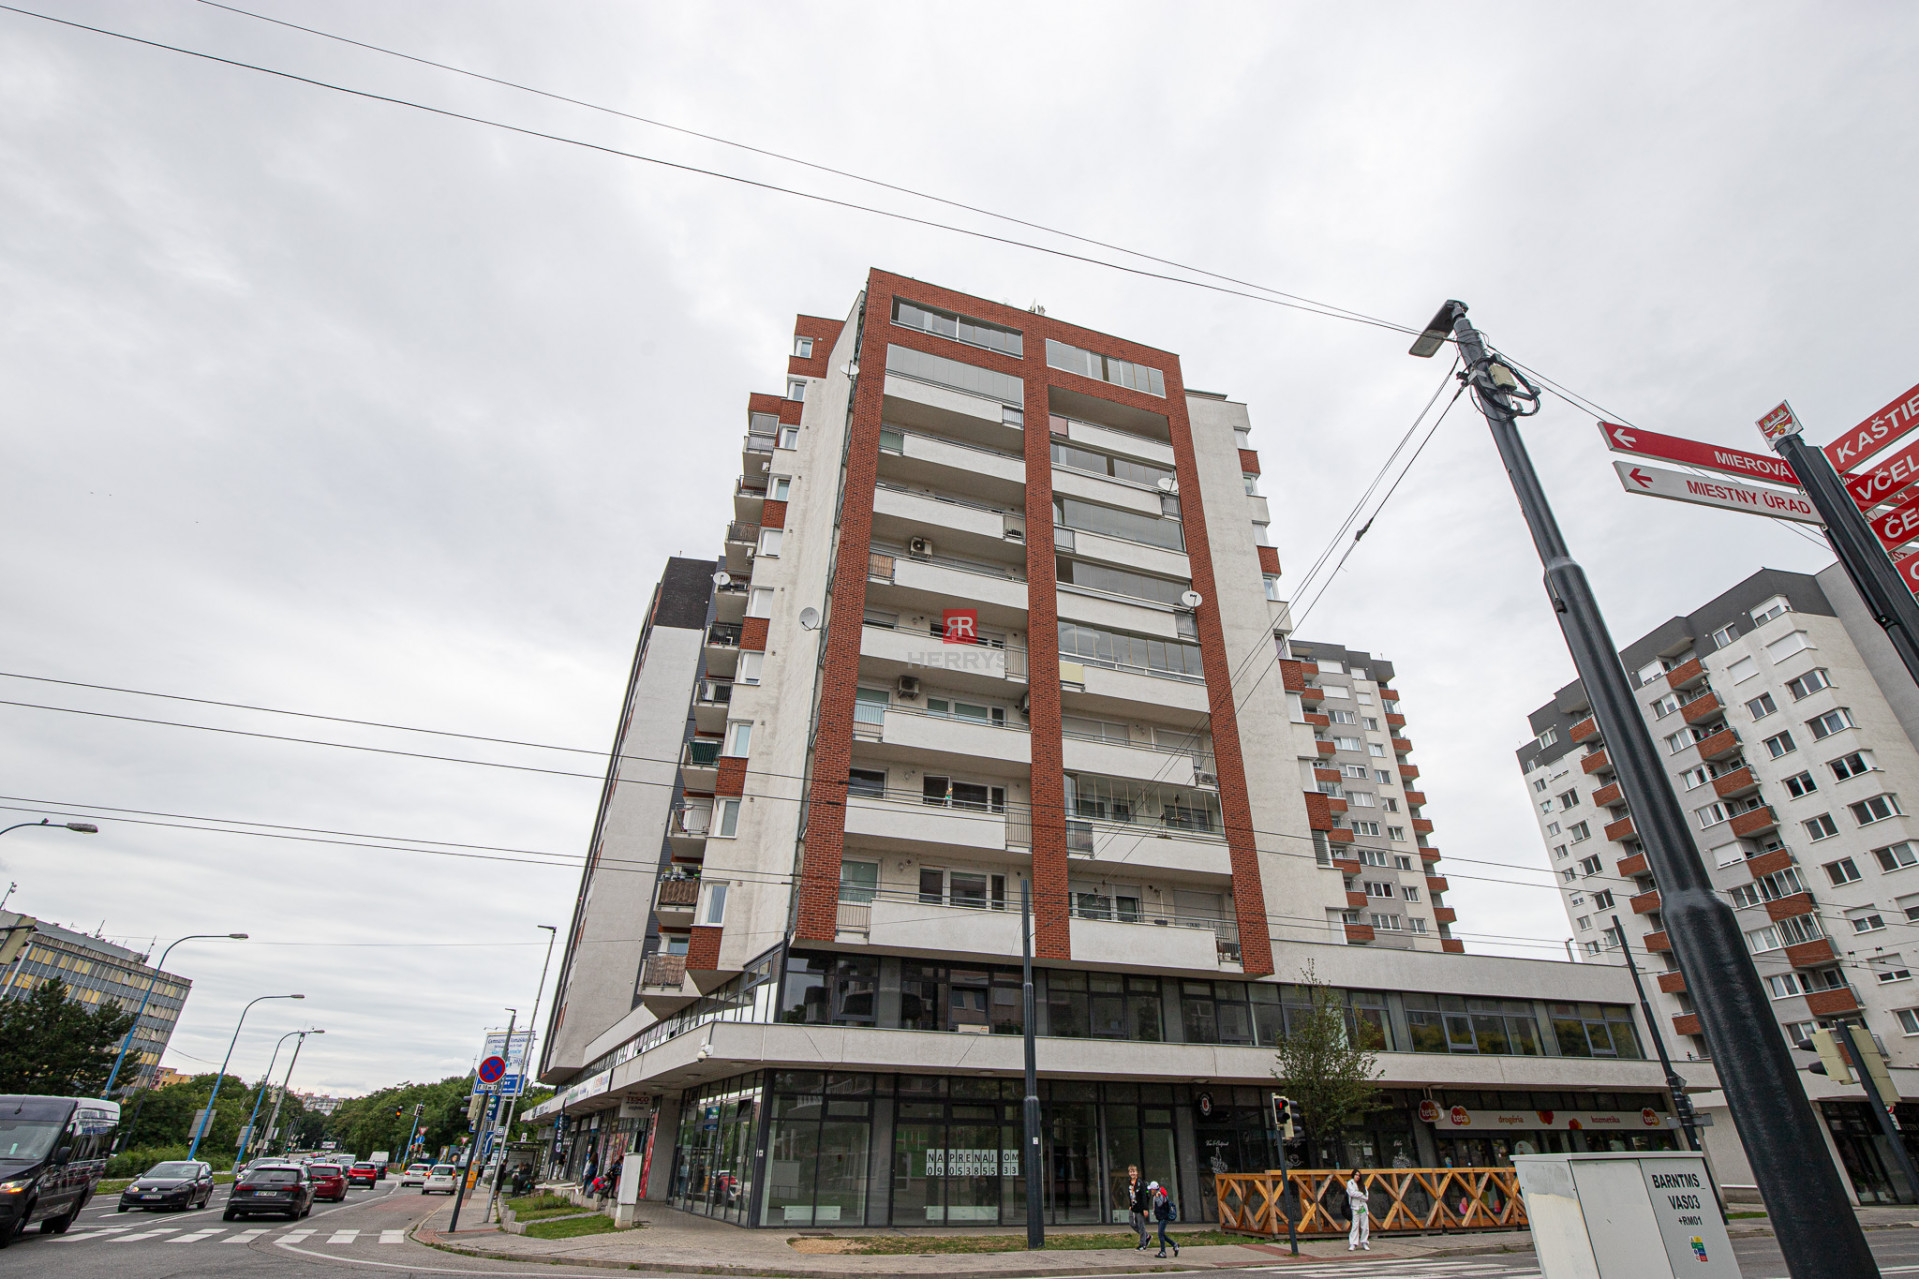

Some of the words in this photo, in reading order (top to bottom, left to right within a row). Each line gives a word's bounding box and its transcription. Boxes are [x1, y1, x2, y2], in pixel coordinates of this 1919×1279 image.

[1713, 450, 1793, 479] MIEROVÁ
[1686, 480, 1757, 505] MIESTNY
[1763, 491, 1811, 514] ÚRAD
[1884, 506, 1919, 539] ČE
[1421, 1108, 1438, 1117] teta
[1453, 1112, 1468, 1121] teta
[1643, 1115, 1658, 1123] teta
[928, 1153, 943, 1162] NA
